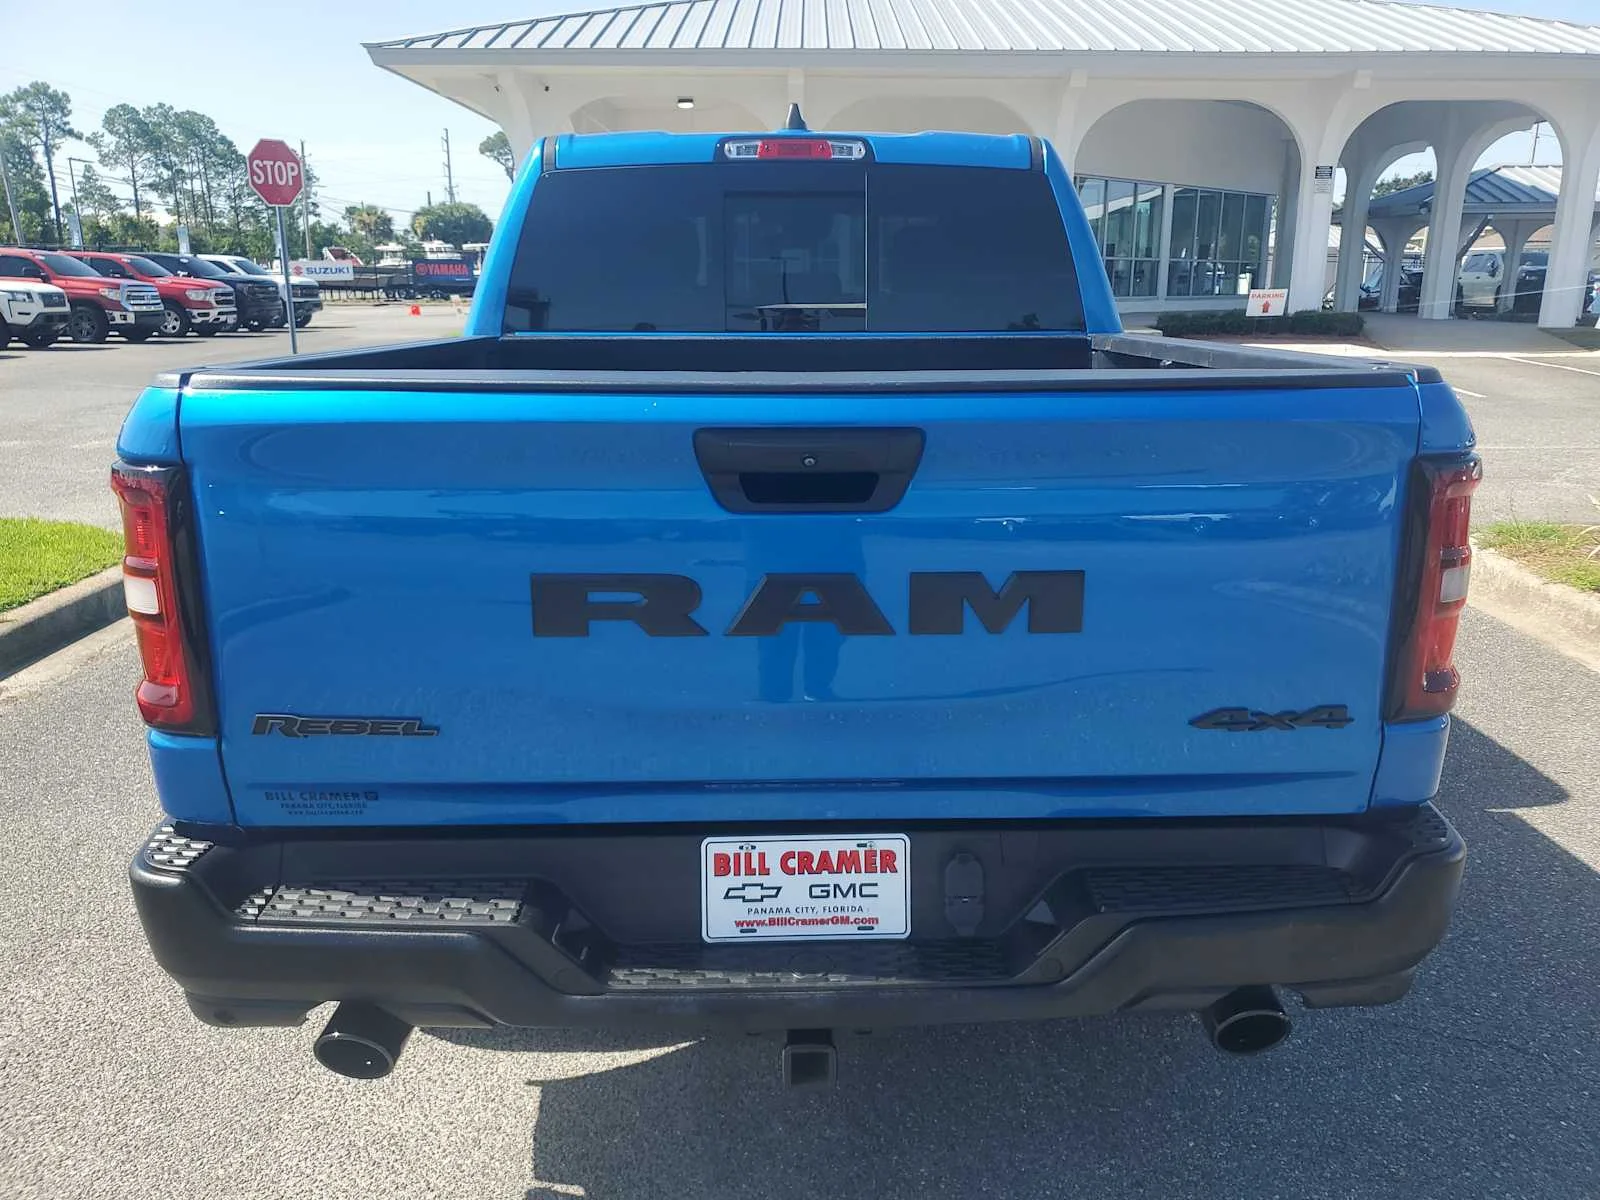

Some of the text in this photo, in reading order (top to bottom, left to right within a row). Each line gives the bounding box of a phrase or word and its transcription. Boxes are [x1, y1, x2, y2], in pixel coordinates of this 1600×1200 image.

[253, 160, 299, 186] STOP
[305, 265, 350, 275] SUZUKI
[427, 263, 469, 276] YAMAHA
[530, 570, 1086, 637] RAM
[252, 713, 440, 738] REBEL
[265, 791, 361, 801] BILL CRAMER
[713, 849, 899, 877] BILL CRAMER
[808, 882, 879, 899] GMC
[747, 904, 864, 915] PANAMA CITY, FLORIDA
[734, 915, 879, 928] www.BillCramerGM.com
